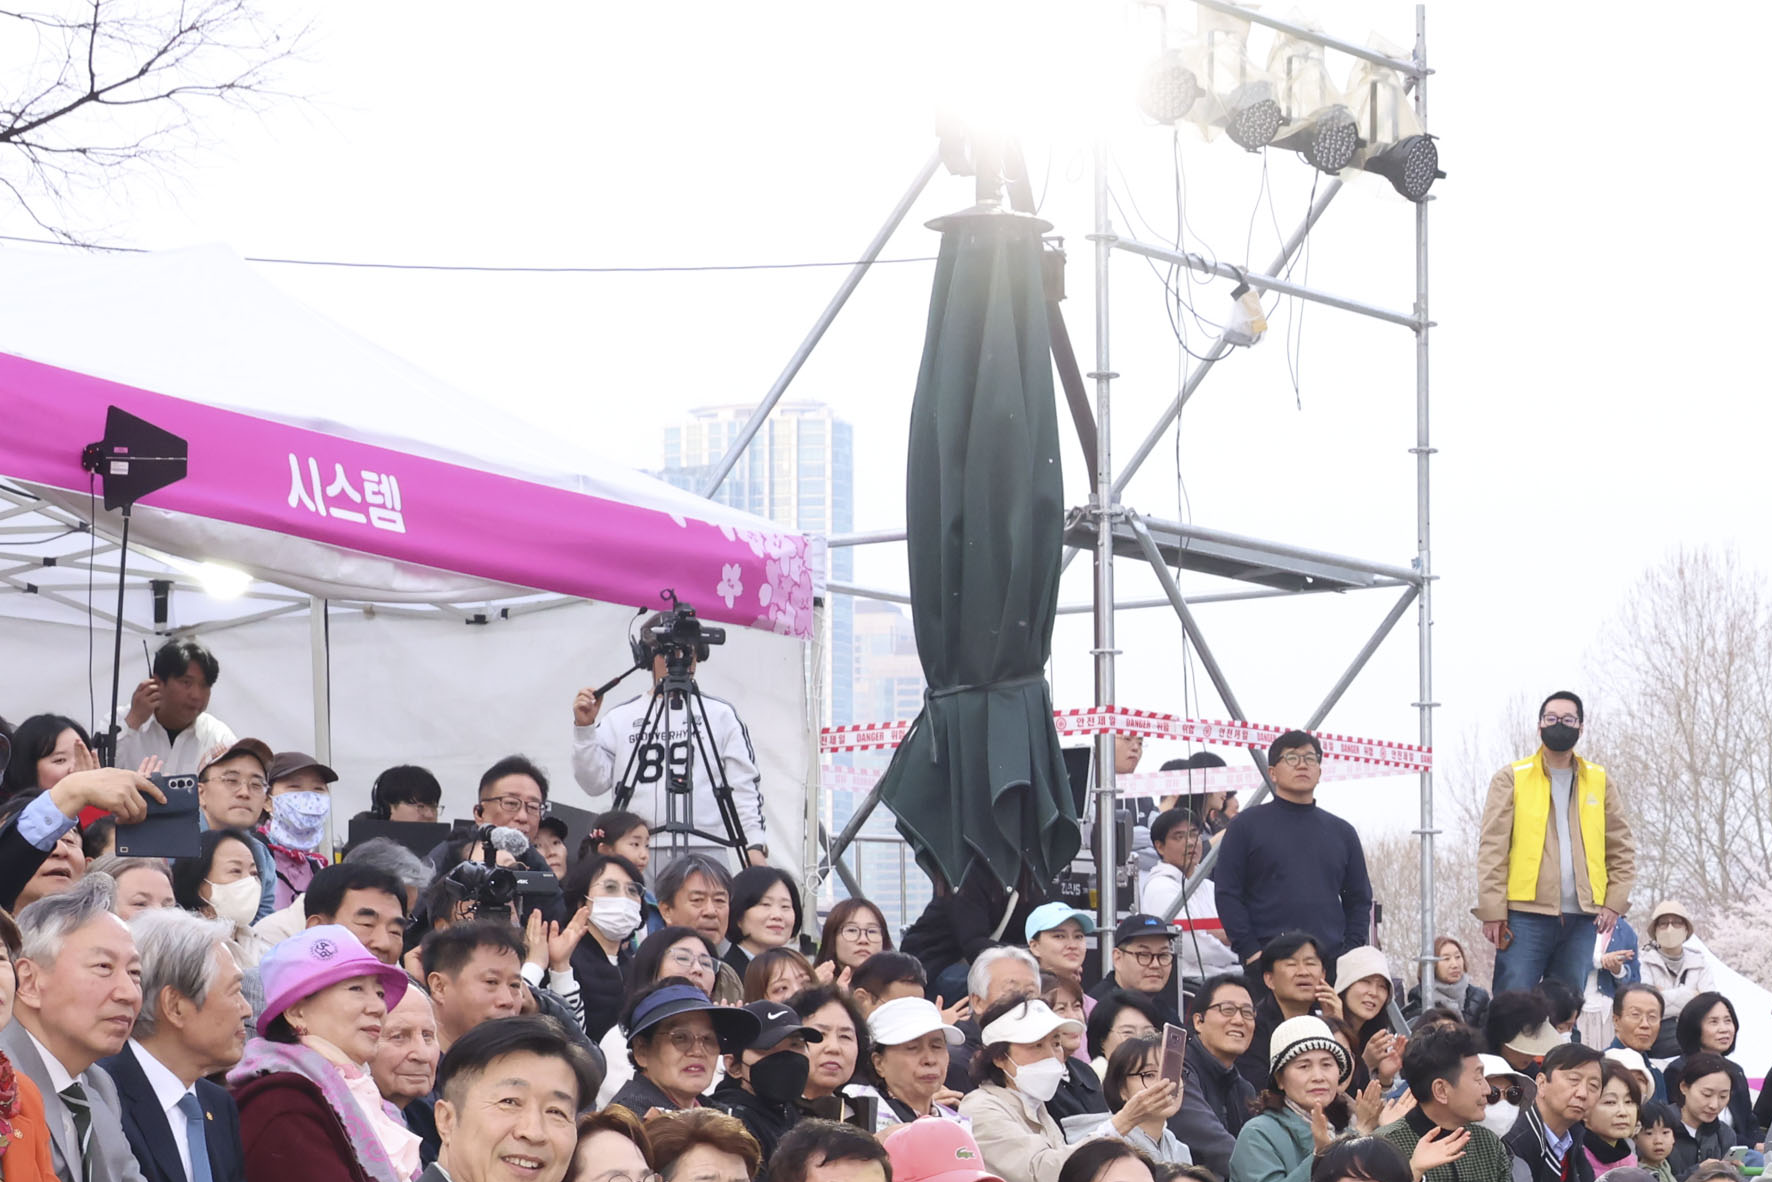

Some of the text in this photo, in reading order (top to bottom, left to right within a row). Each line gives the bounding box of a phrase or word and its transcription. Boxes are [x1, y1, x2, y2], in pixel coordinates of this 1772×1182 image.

[288, 452, 406, 533] 시스템
[1076, 715, 1116, 728] 안전제일
[1126, 718, 1151, 730] DANGER
[857, 732, 884, 743] DANGER
[638, 740, 694, 783] 89
